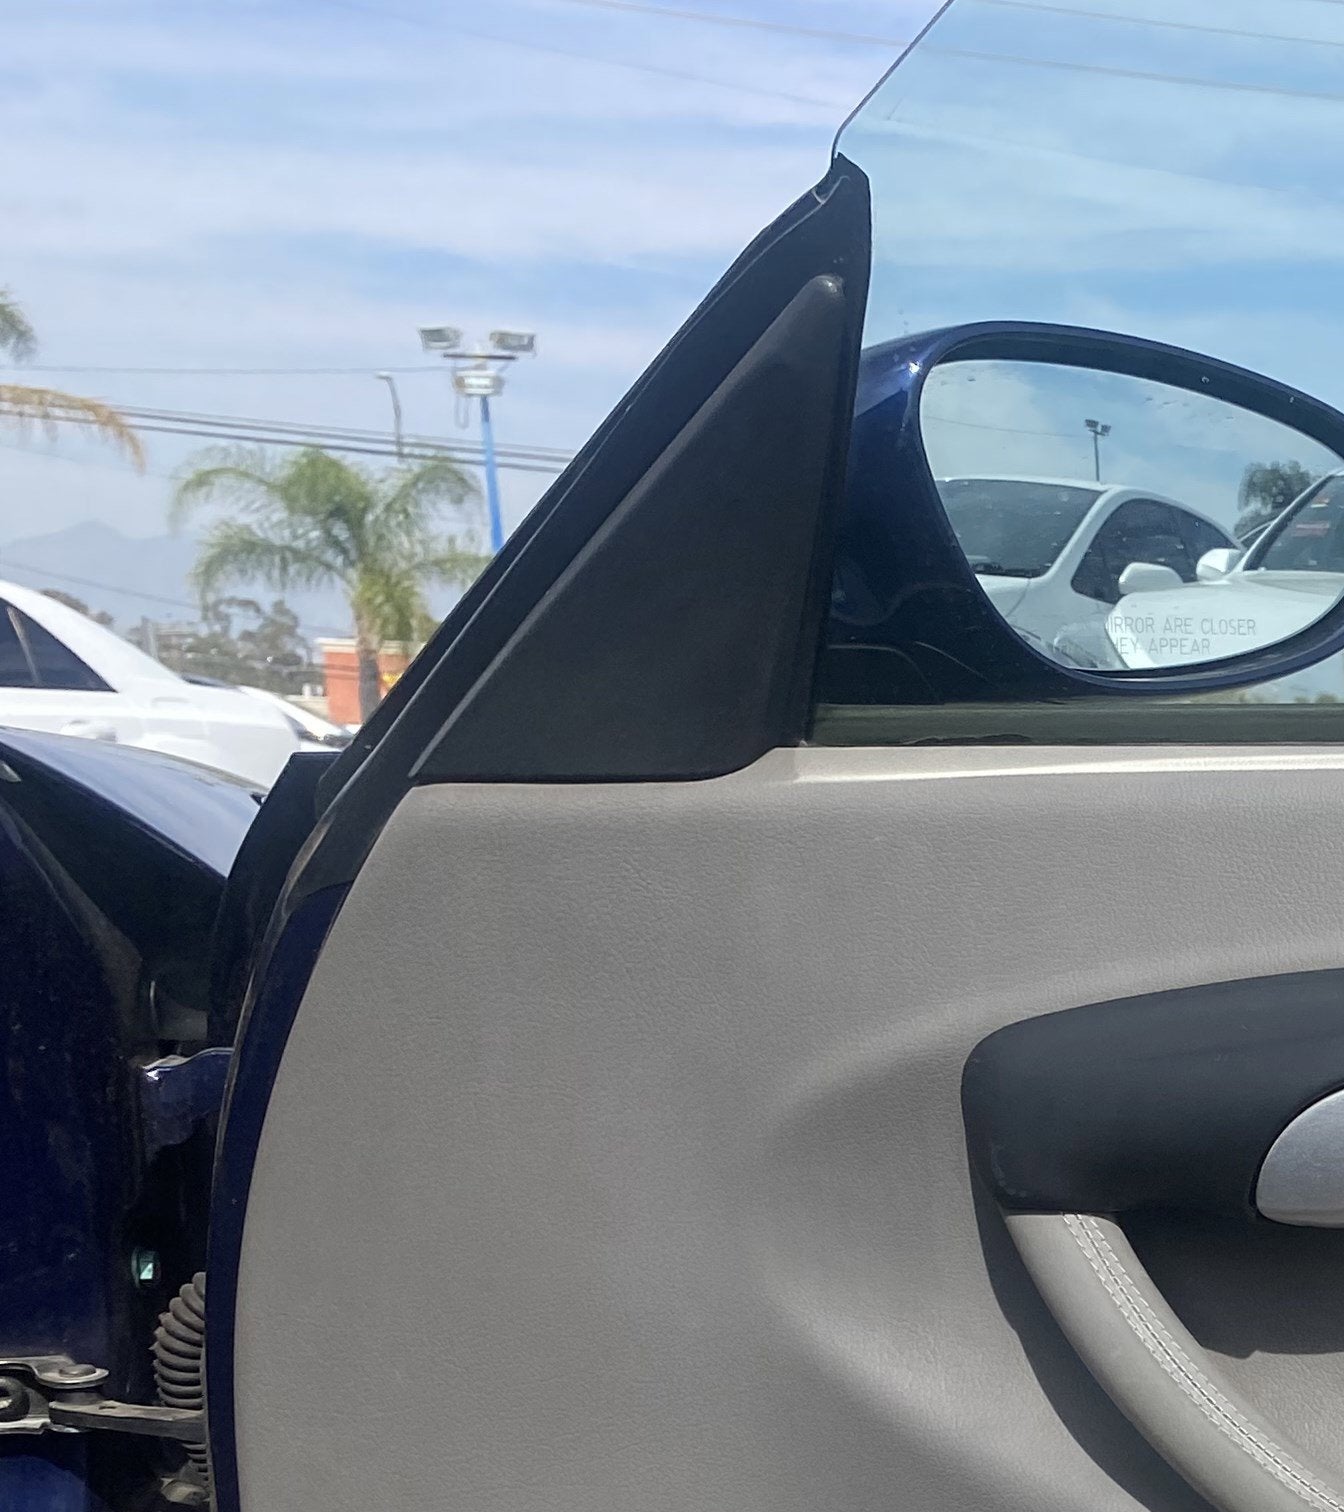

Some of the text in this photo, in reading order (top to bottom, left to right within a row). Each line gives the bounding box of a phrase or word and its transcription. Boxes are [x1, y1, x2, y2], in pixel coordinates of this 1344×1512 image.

[1163, 617, 1194, 635] ARE
[1200, 618, 1256, 636] CLOSER
[1149, 638, 1212, 655] APPEAR
